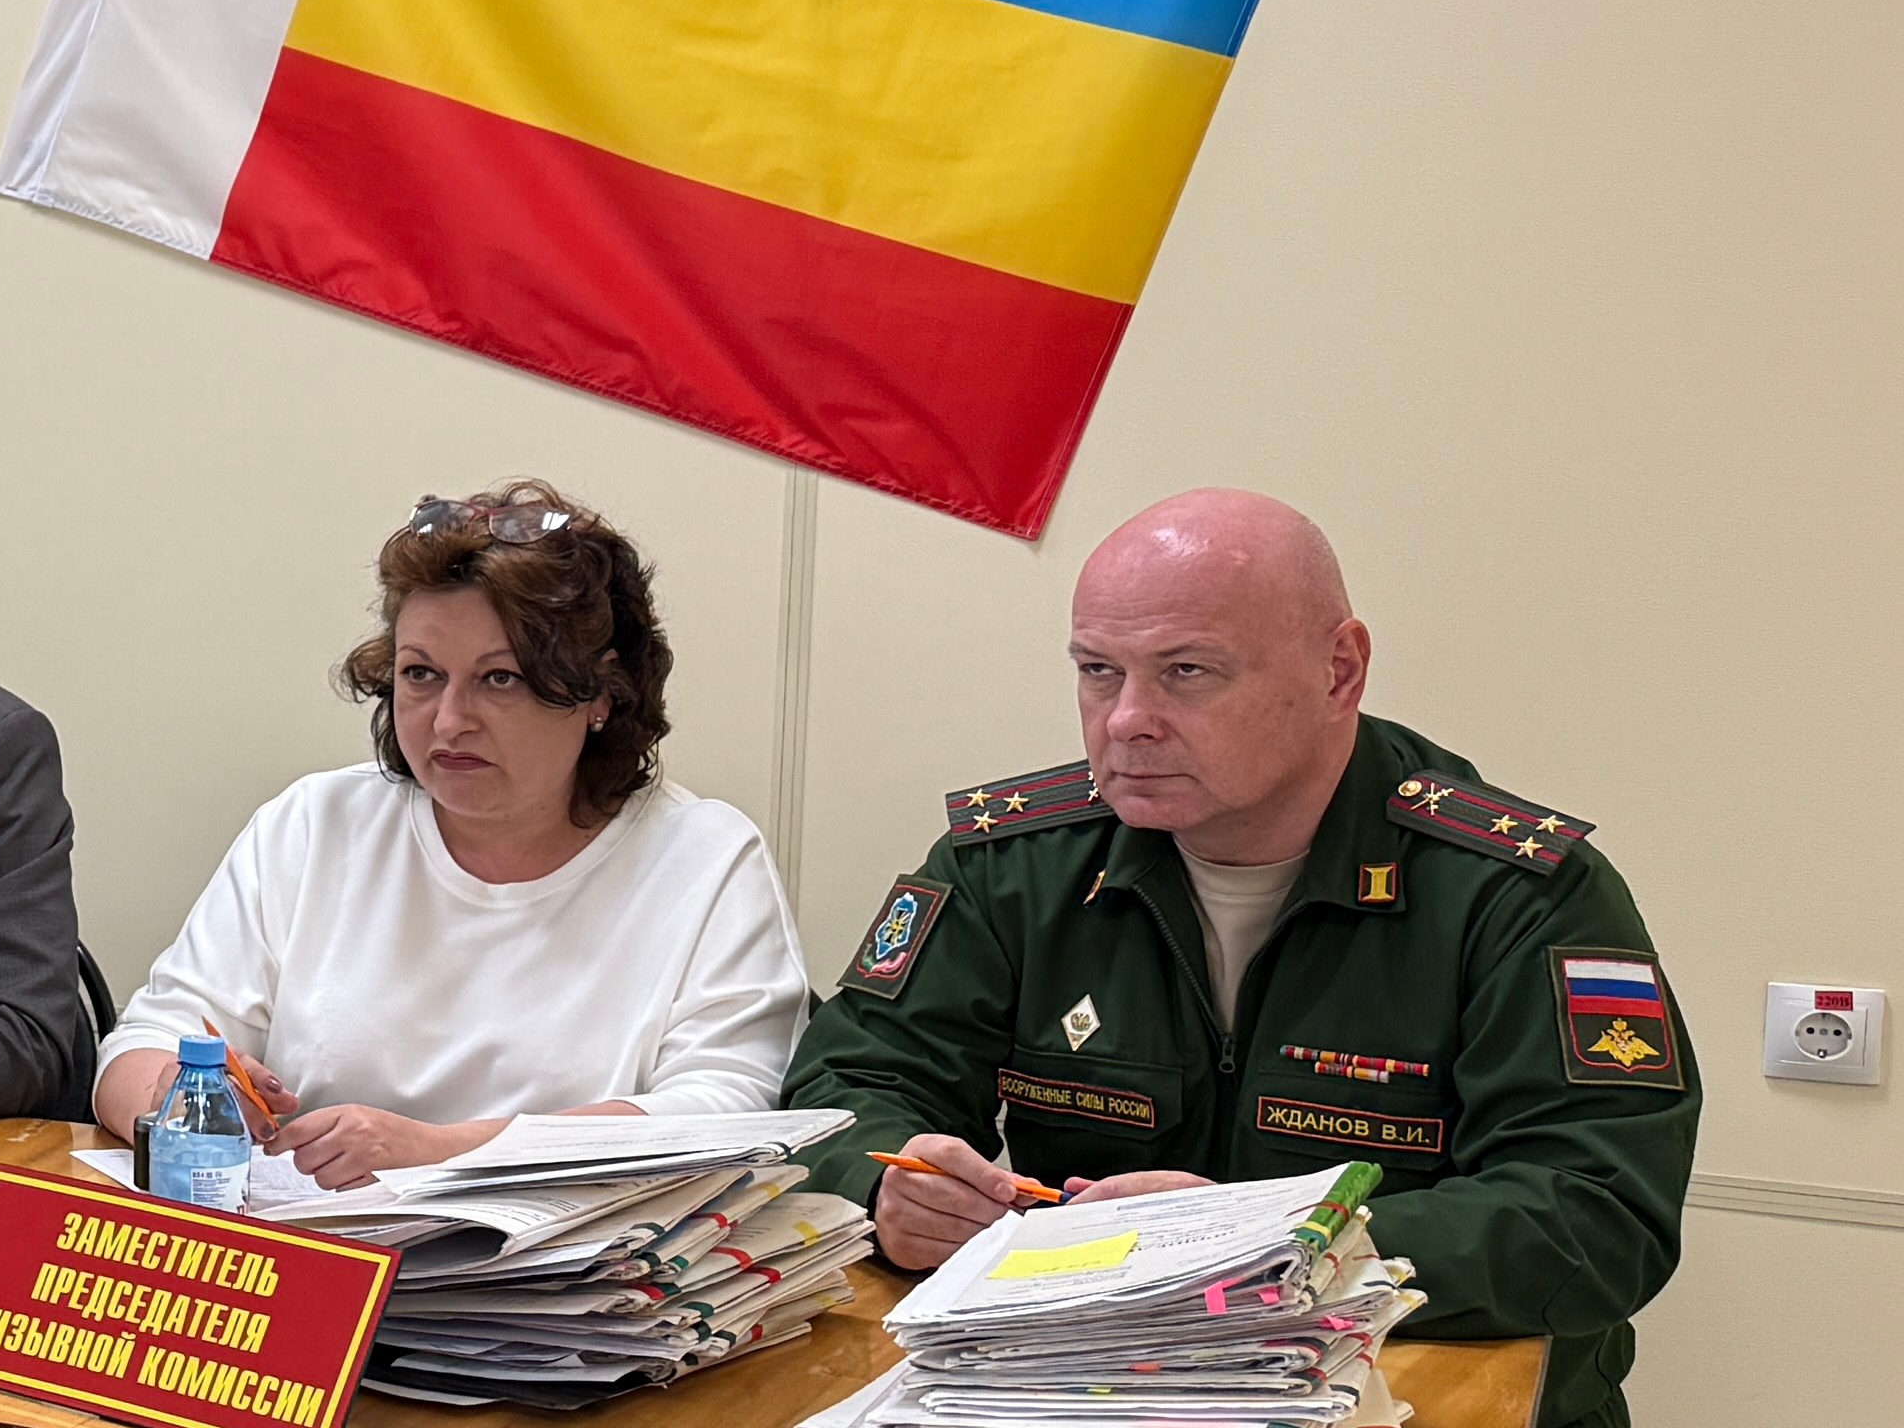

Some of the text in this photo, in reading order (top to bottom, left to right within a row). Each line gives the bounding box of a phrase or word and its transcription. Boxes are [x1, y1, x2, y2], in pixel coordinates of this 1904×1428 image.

[1001, 1075, 1151, 1119] ВООРУЖЕННЫЕ СИЛЫ РОССИИ
[1266, 1105, 1431, 1144] ЖДАНОВ В.И.
[55, 1212, 278, 1296] ЗАМЕСТИТЕЛЬ
[30, 1263, 270, 1353] ПРЕДСЕДАТЕЛЯ
[136, 1346, 324, 1427] КОМИССИИ
